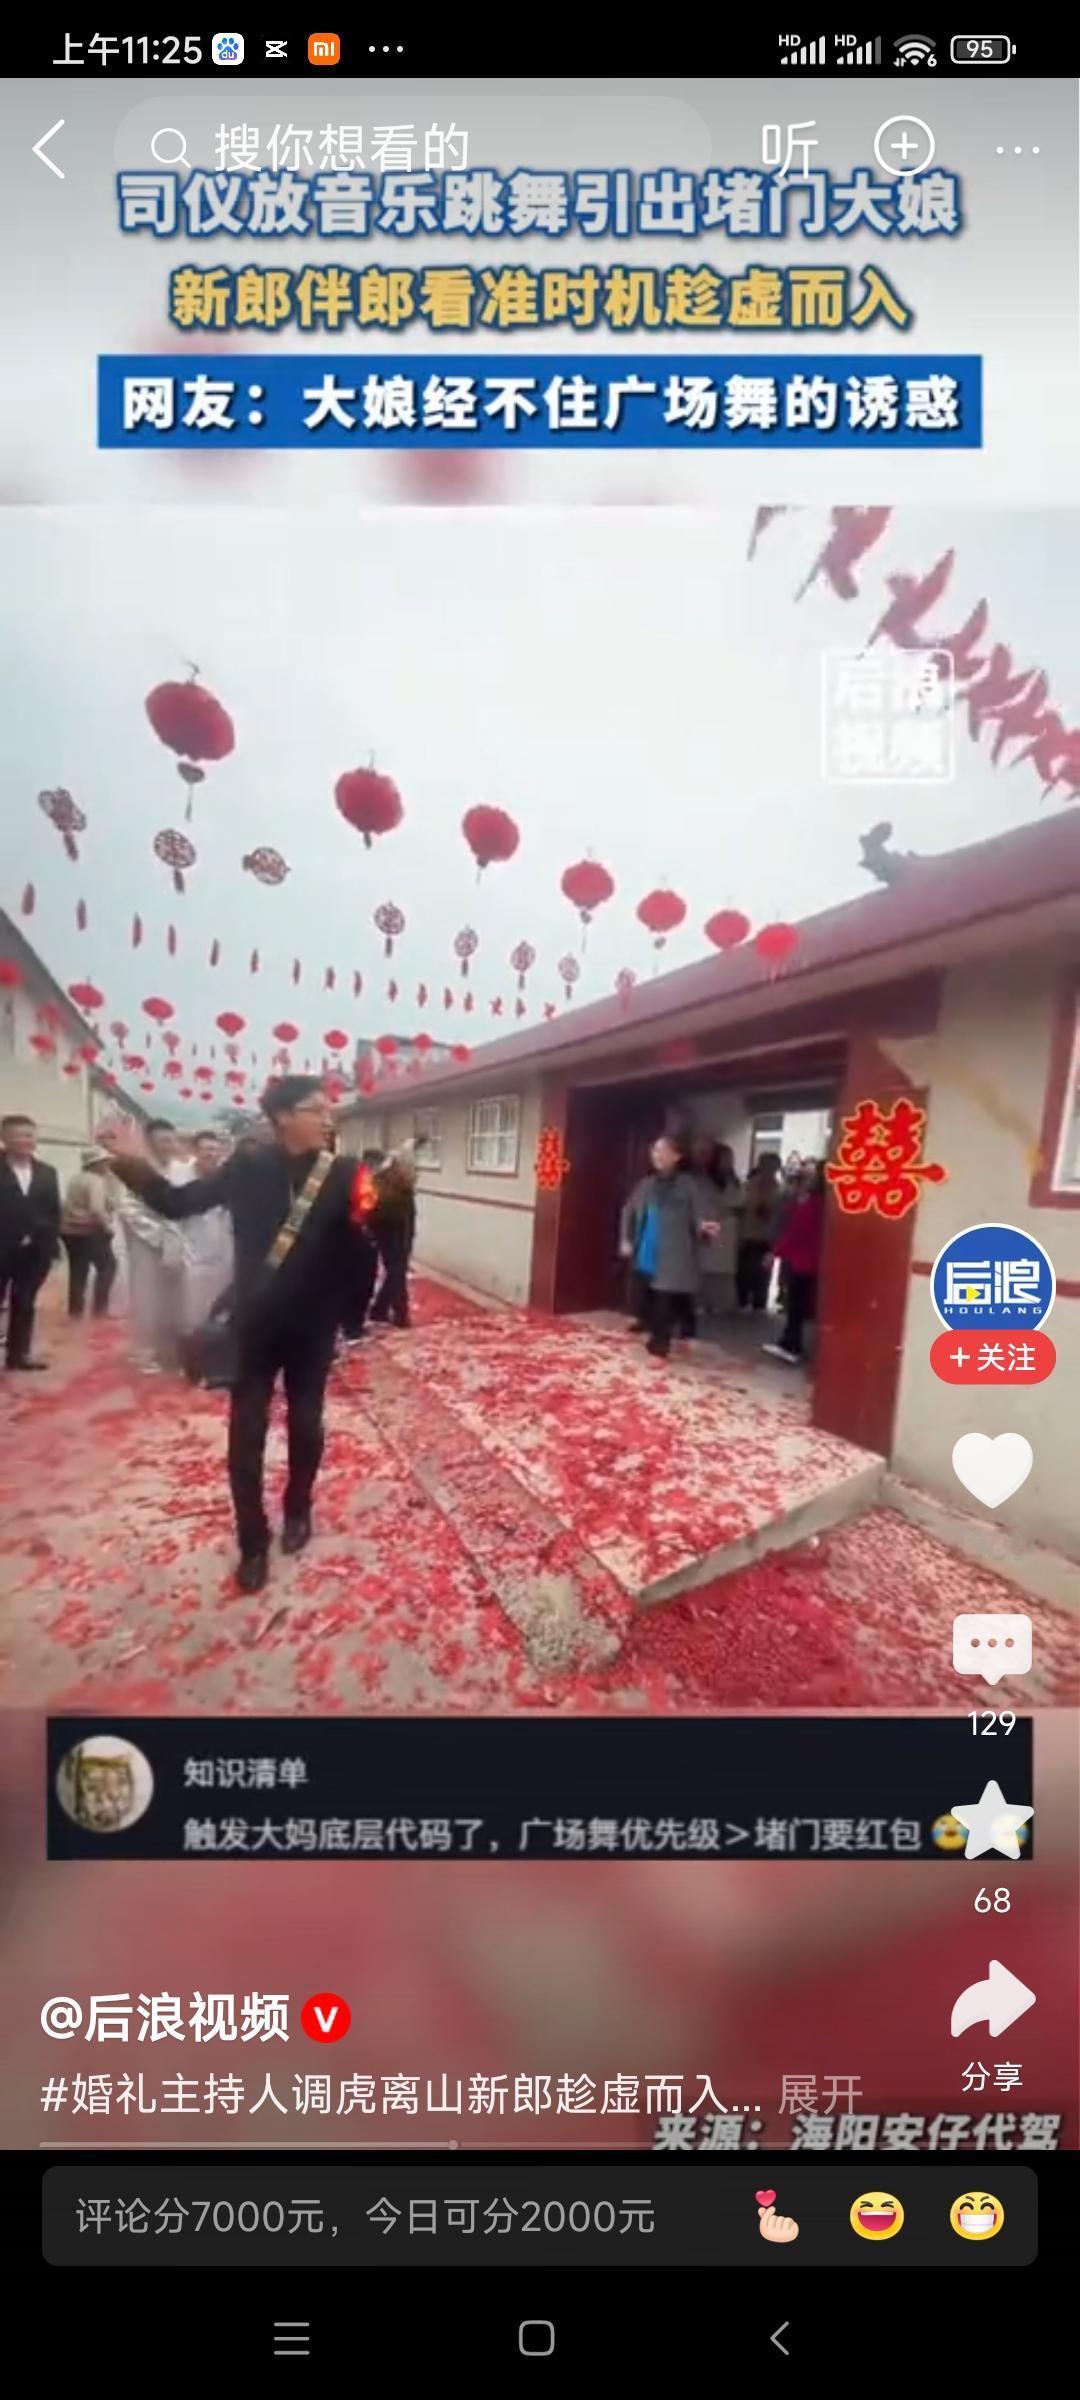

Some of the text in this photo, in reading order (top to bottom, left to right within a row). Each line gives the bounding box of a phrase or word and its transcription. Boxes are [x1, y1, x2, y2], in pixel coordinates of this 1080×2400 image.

[52, 32, 203, 66] 上午11:25
[778, 34, 801, 47] HD
[834, 34, 857, 47] HD
[966, 39, 993, 58] 95
[214, 122, 469, 172] 搜你想看的
[762, 120, 818, 179] 听
[943, 1258, 1042, 1305] 后浪
[943, 1306, 1043, 1315] HOULANG
[967, 1710, 1016, 1736] 129
[973, 1887, 1011, 1913] 68
[40, 1991, 290, 2042] @后浪视频
[962, 2061, 1023, 2092] 分享
[778, 2074, 863, 2115] 展开
[75, 2196, 656, 2238] 评论分7000元，今日可分2000元
